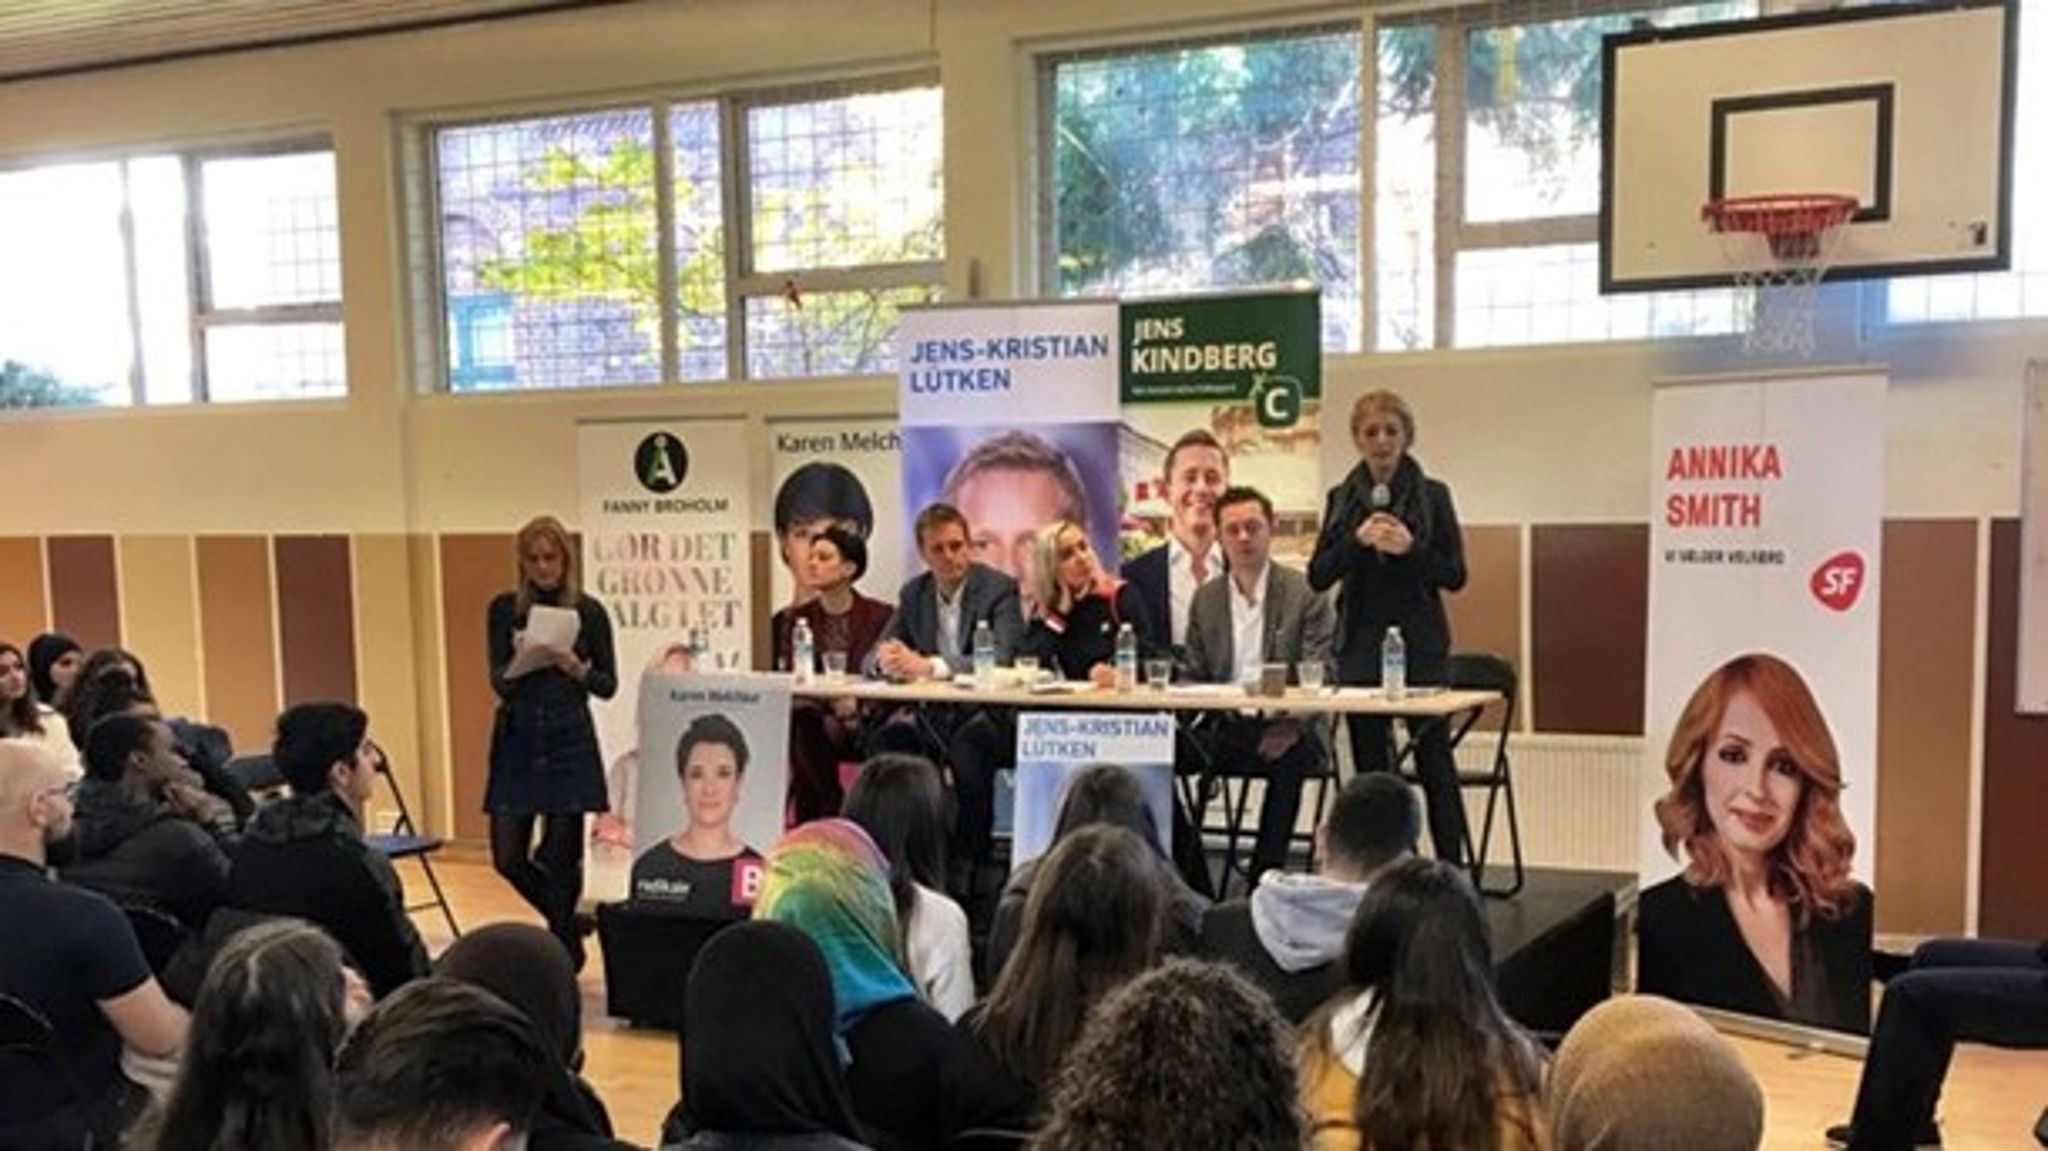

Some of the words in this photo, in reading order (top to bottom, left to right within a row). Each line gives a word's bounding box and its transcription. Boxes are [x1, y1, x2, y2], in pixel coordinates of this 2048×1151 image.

[1132, 318, 1184, 346] JENS
[910, 334, 1109, 364] JENS-KRISTIAN
[1131, 342, 1278, 374] KINDBERG
[911, 366, 1012, 393] LÜTKEN
[1265, 387, 1290, 419] C
[777, 432, 834, 452] Karen
[840, 431, 901, 451] Melch
[1666, 444, 1782, 481] ANNIKA
[603, 500, 649, 514] FANNY
[654, 498, 730, 514] BROHOLM
[1666, 493, 1761, 528] SMITH
[670, 532, 737, 561] DET
[1821, 566, 1858, 595] SF
[612, 600, 672, 628] ALG
[1022, 718, 1169, 736] JENS-KRISTIAN
[741, 865, 762, 897] B
